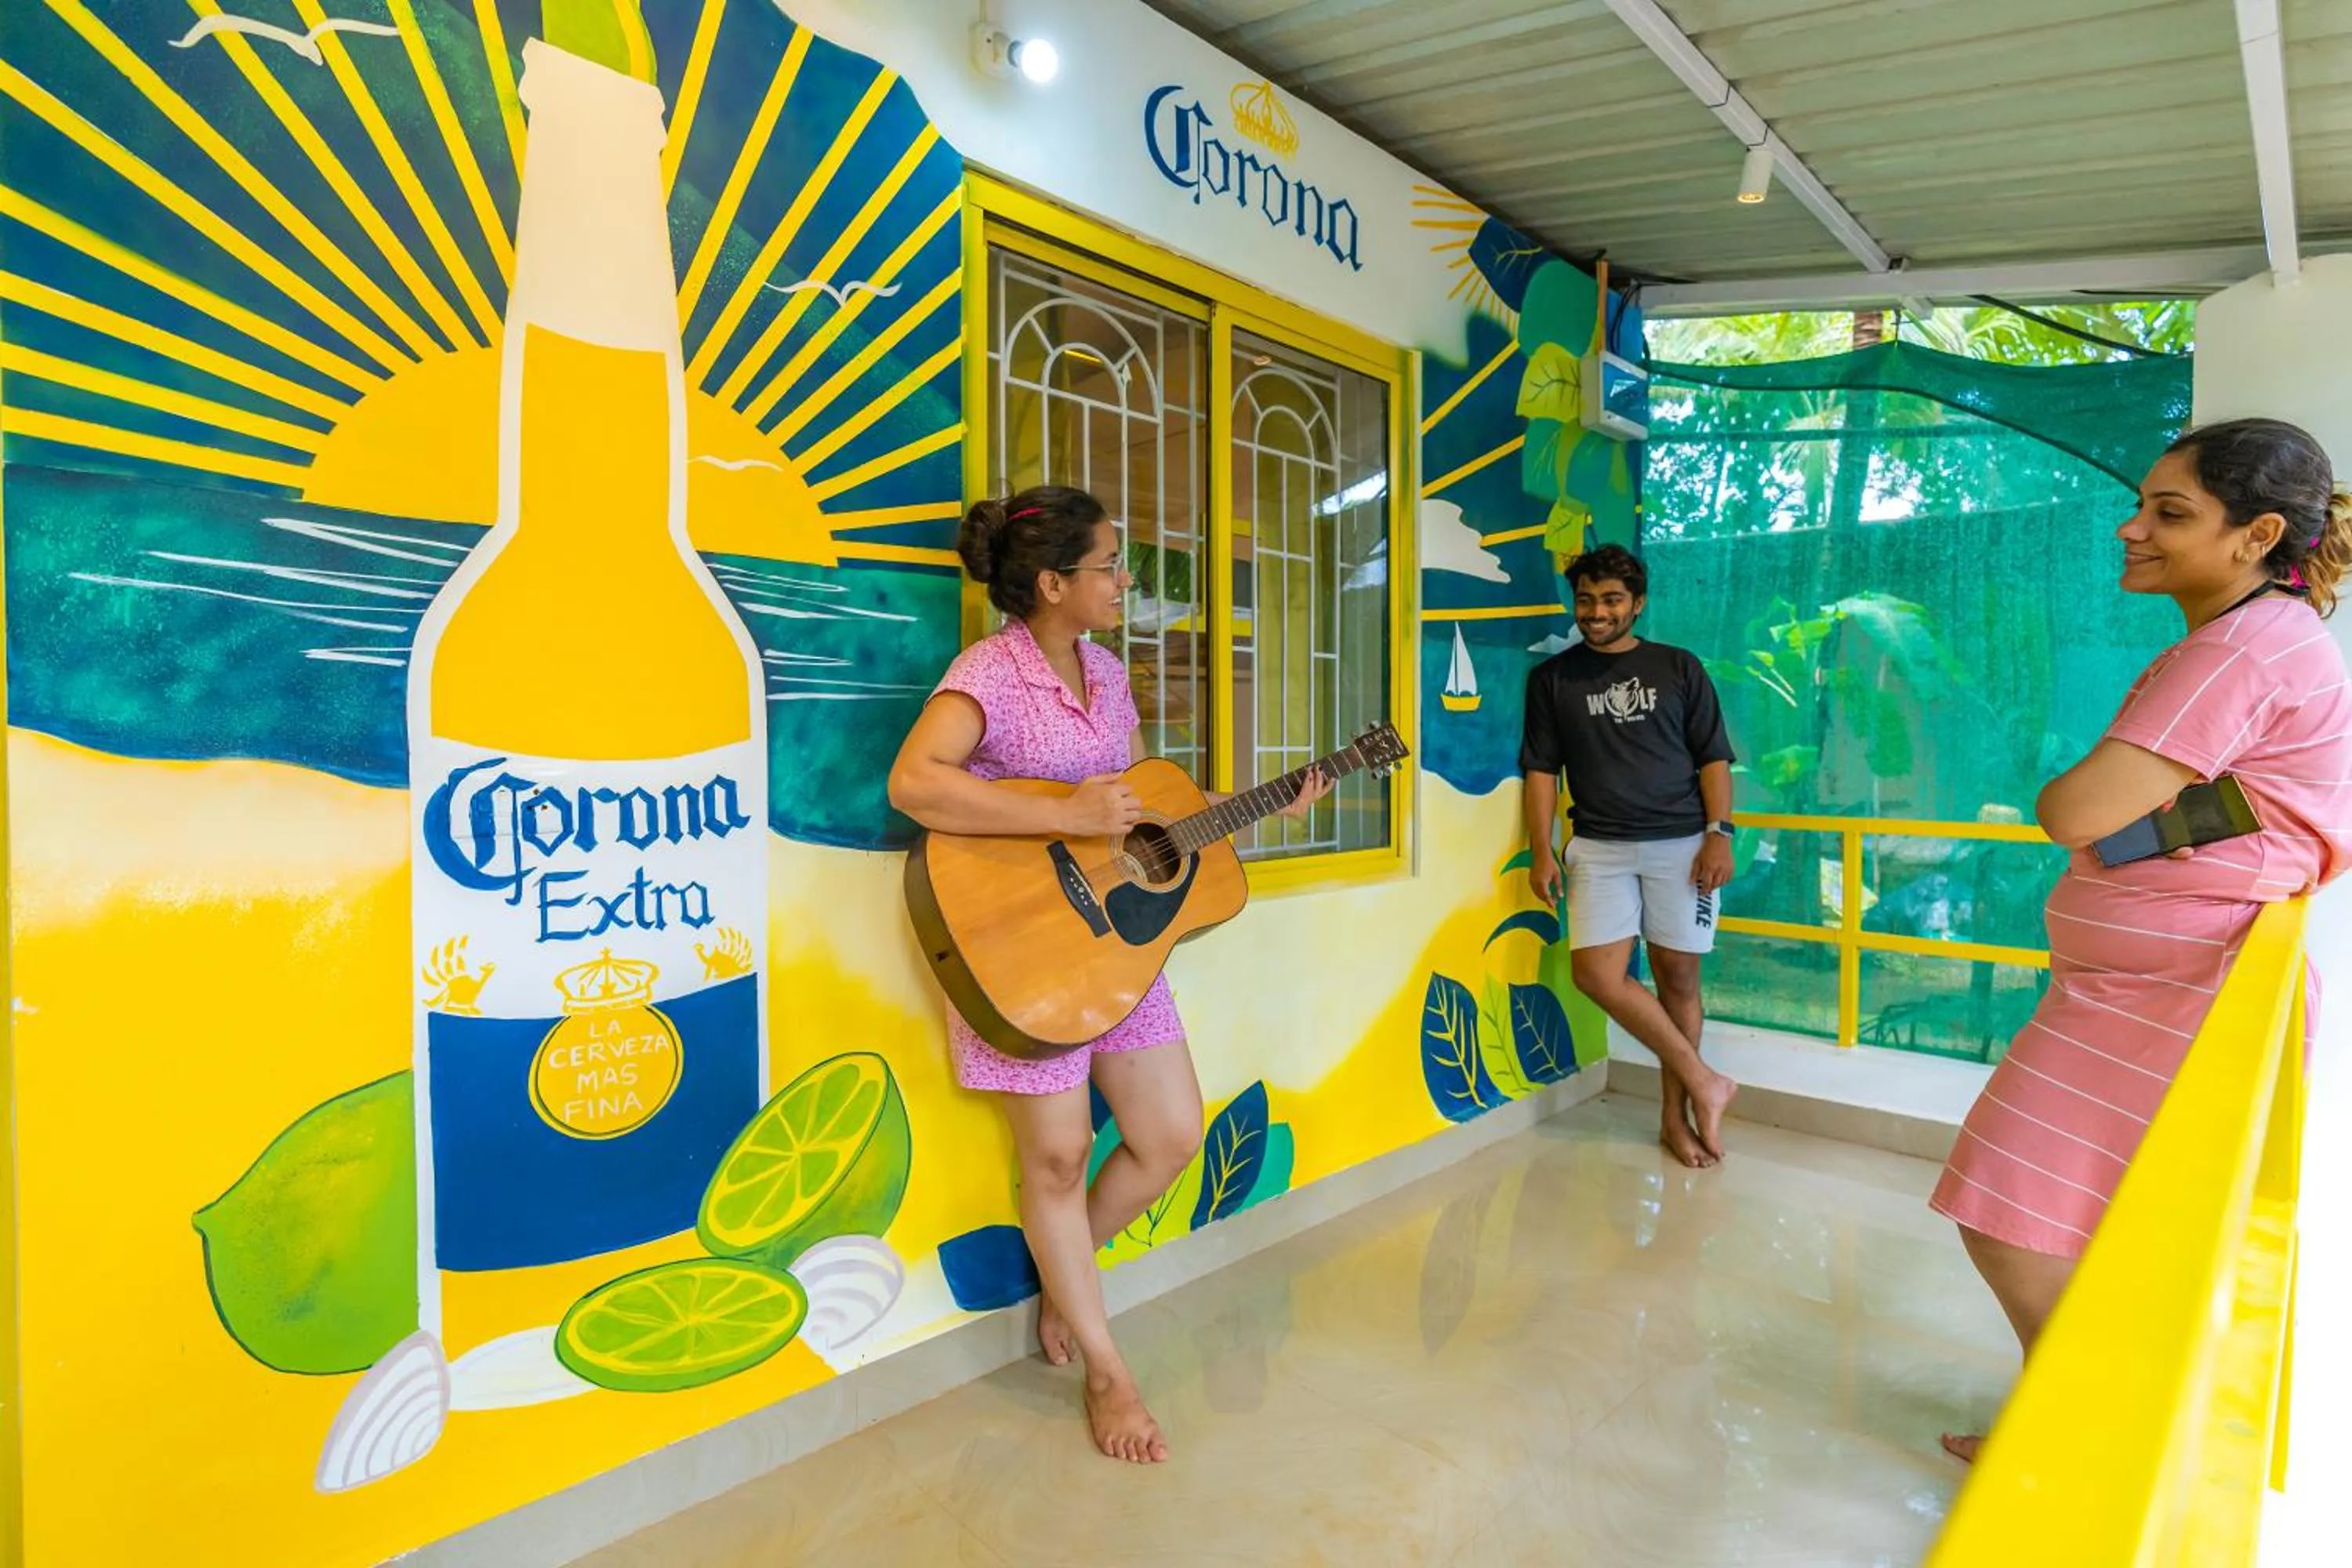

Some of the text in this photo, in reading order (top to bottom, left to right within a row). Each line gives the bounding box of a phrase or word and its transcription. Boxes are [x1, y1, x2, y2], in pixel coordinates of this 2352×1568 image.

[1144, 85, 1363, 271] Corona
[1586, 677, 1657, 716] WOLF
[423, 757, 751, 905] Corona
[535, 866, 715, 943] Extra
[589, 1018, 622, 1039] LA
[549, 1034, 669, 1069] CERVEZA
[576, 1063, 639, 1094] MAS
[563, 1091, 644, 1124] FINA
